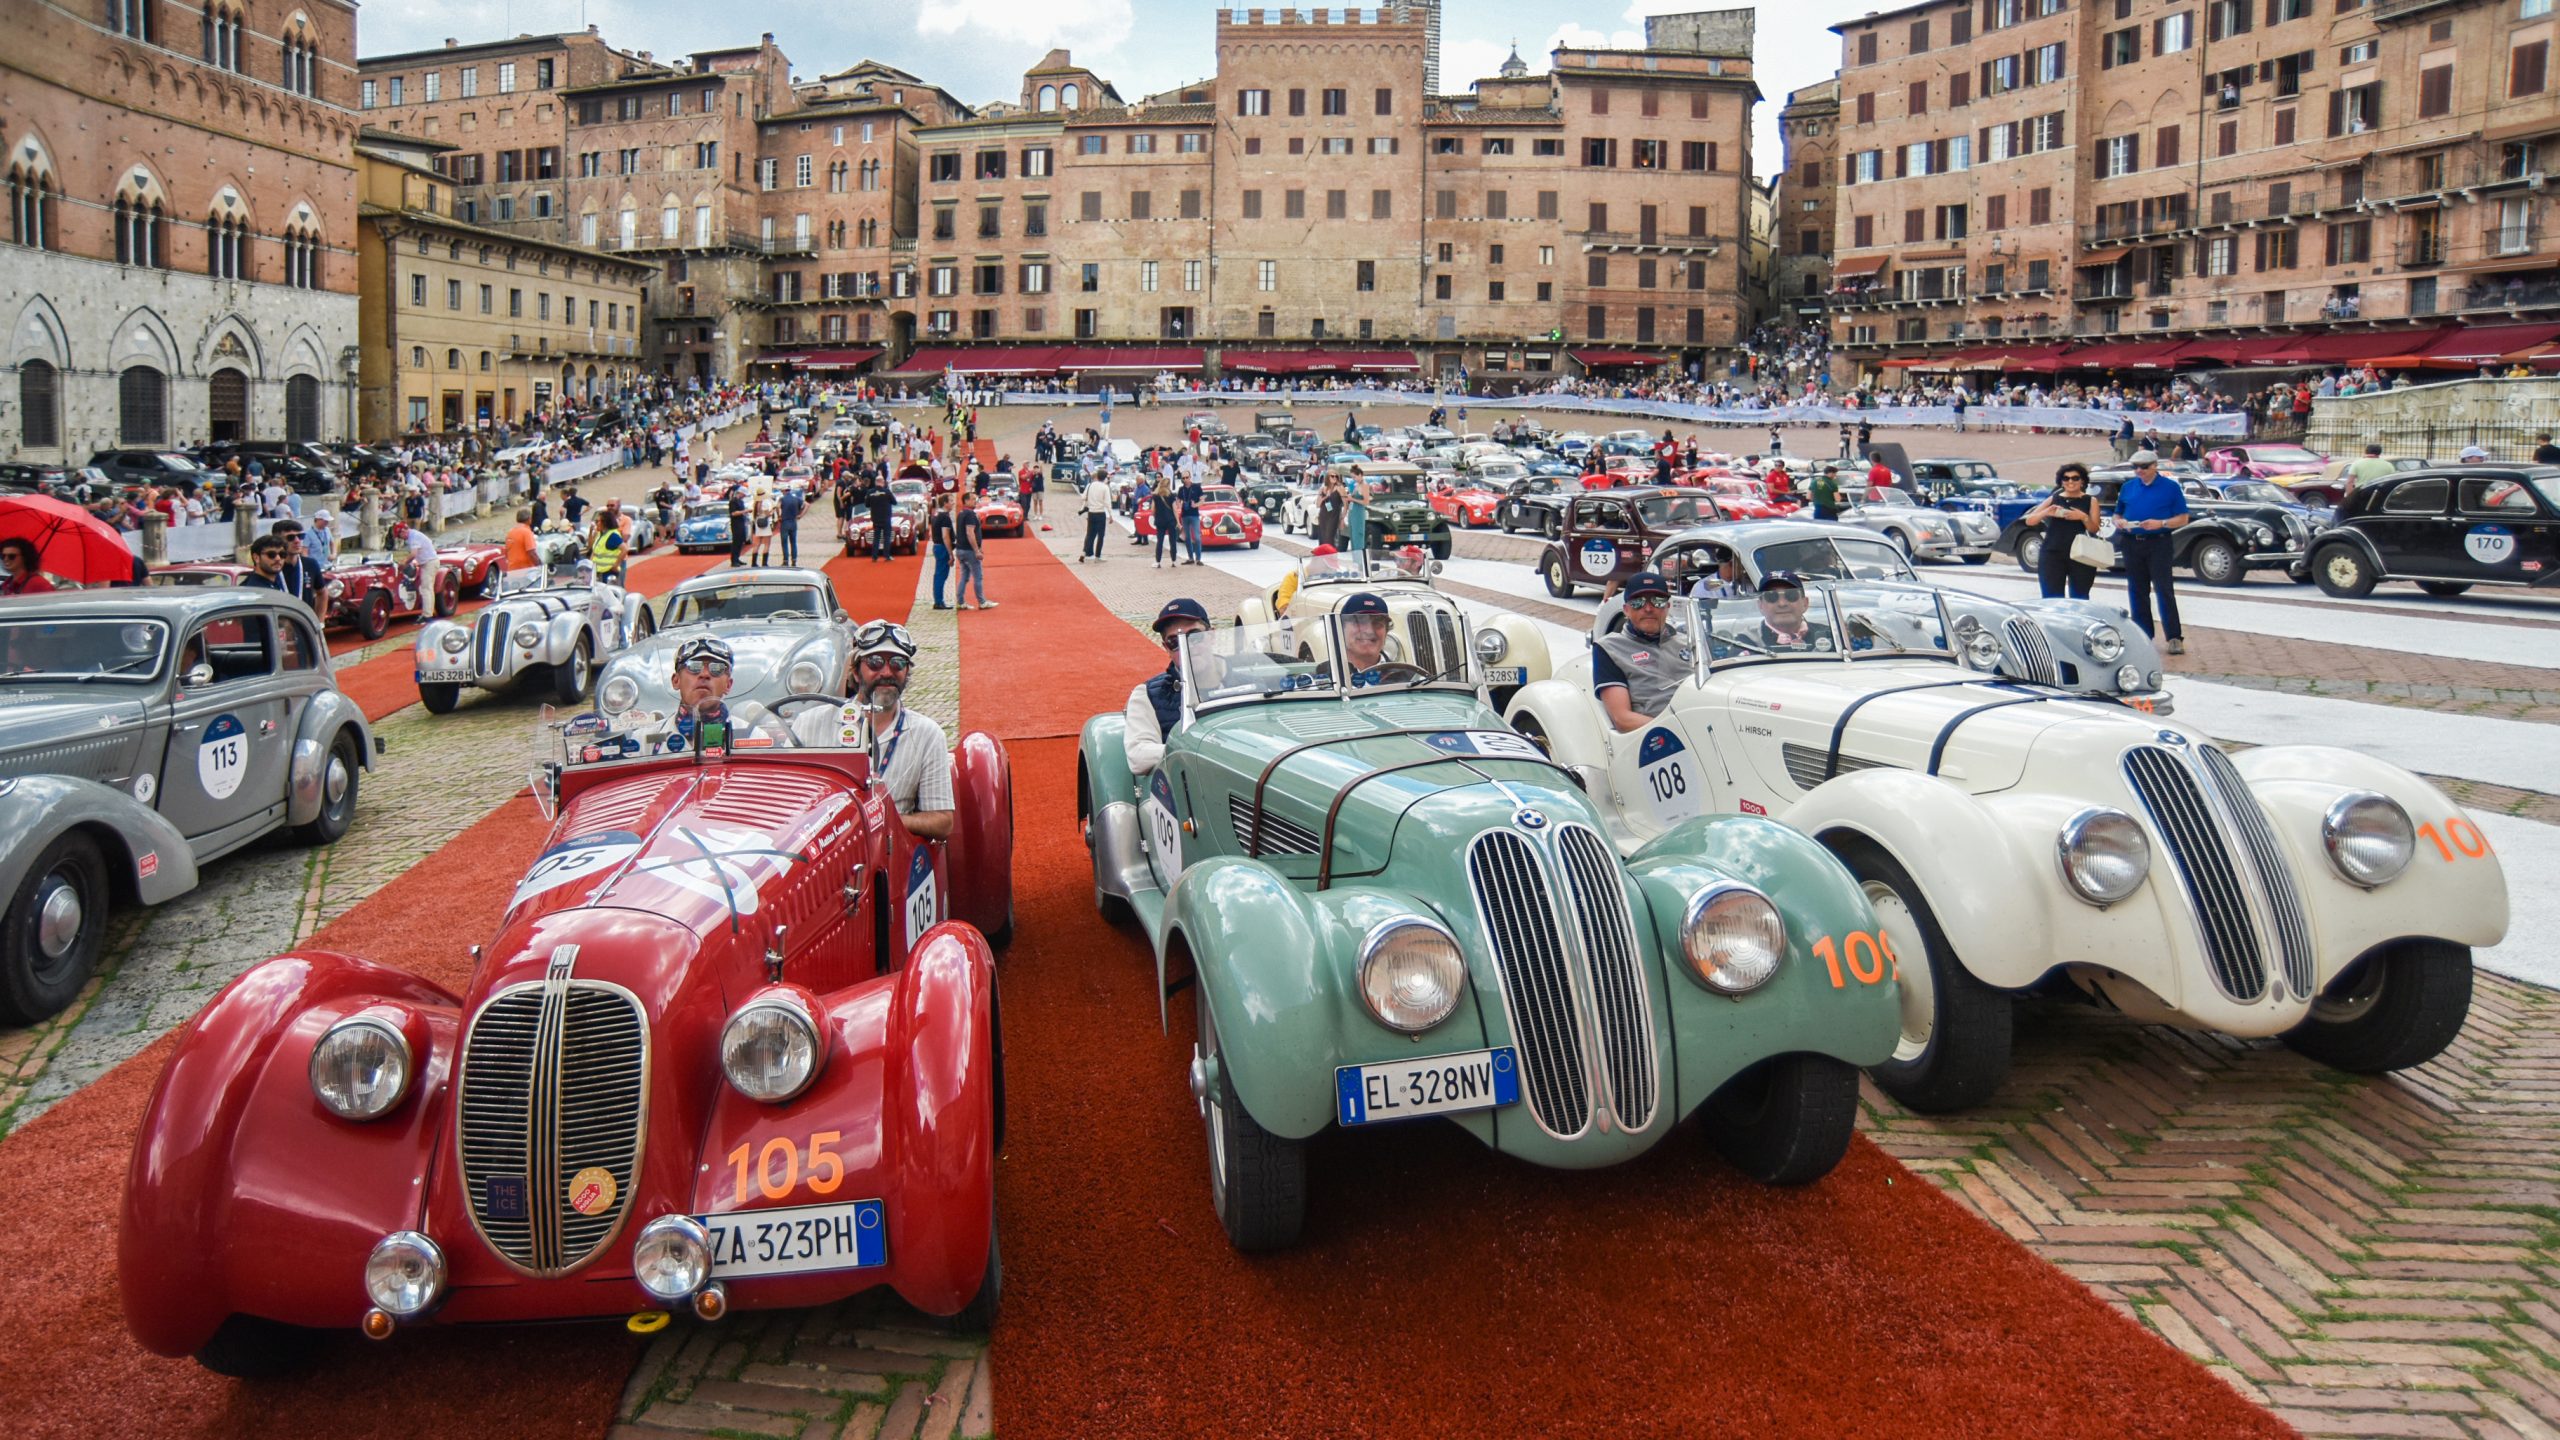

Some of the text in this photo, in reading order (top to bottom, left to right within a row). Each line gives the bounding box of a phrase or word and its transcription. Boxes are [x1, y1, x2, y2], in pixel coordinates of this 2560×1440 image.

[1308, 363, 1336, 371] GELATERIA
[2475, 537, 2503, 550] 170
[1587, 553, 1608, 565] 123
[1489, 670, 1518, 682] 328SX
[1745, 726, 1772, 737] HIRSCH
[212, 741, 238, 771] 113
[1649, 762, 1686, 803] 108
[1742, 801, 1761, 813] 1000
[1154, 807, 1174, 855] 109
[2416, 817, 2496, 863] 10
[525, 848, 608, 884] 05
[912, 884, 932, 939] 105
[1366, 1074, 1400, 1110] EL
[1408, 1062, 1490, 1105] 328NV
[727, 1130, 844, 1203] 105
[493, 1184, 517, 1197] THE
[575, 1188, 592, 1206] 1000
[496, 1198, 518, 1210] ICE
[579, 1192, 597, 1212] MIGLIA
[709, 1215, 853, 1266] ZA 323PH
